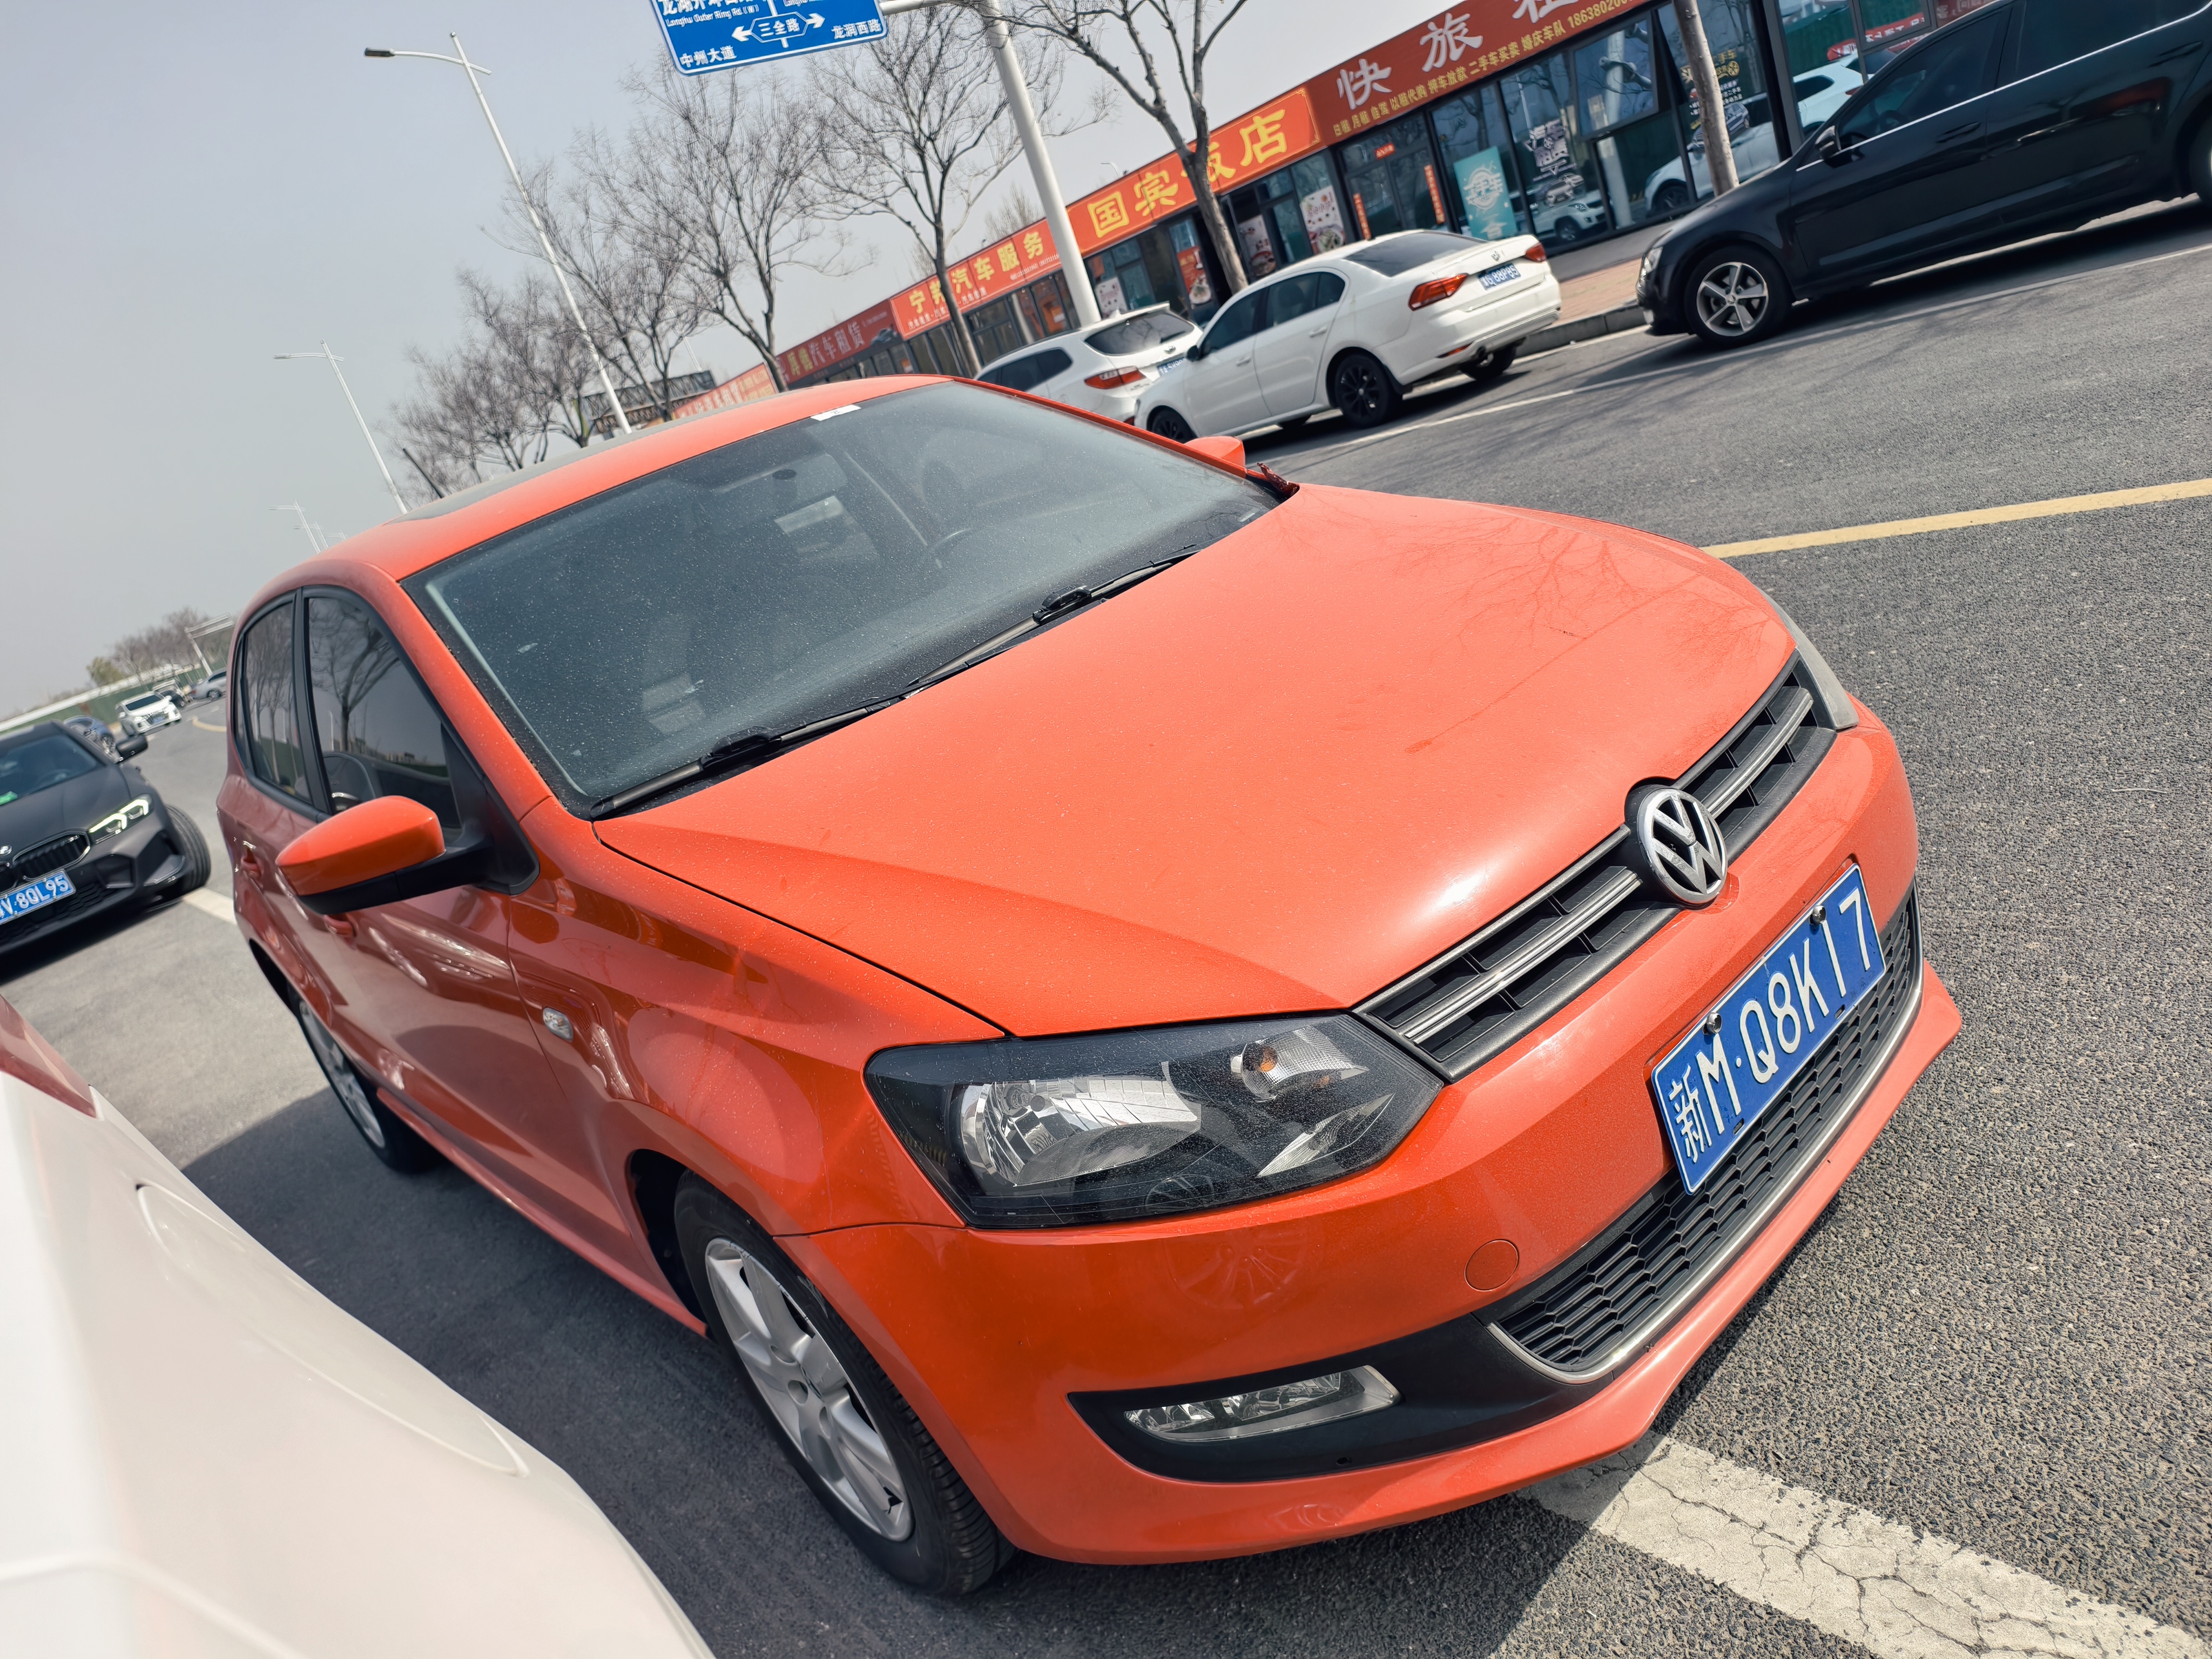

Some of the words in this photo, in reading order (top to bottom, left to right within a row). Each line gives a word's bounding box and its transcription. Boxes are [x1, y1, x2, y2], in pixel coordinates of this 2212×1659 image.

[693, 13, 713, 21] Outer
[714, 10, 732, 19] Ring
[758, 18, 800, 37] 三全路
[679, 45, 737, 68] 中州大道
[1468, 42, 1520, 75] 二手车买卖
[1521, 20, 1566, 51] 婚庆车队
